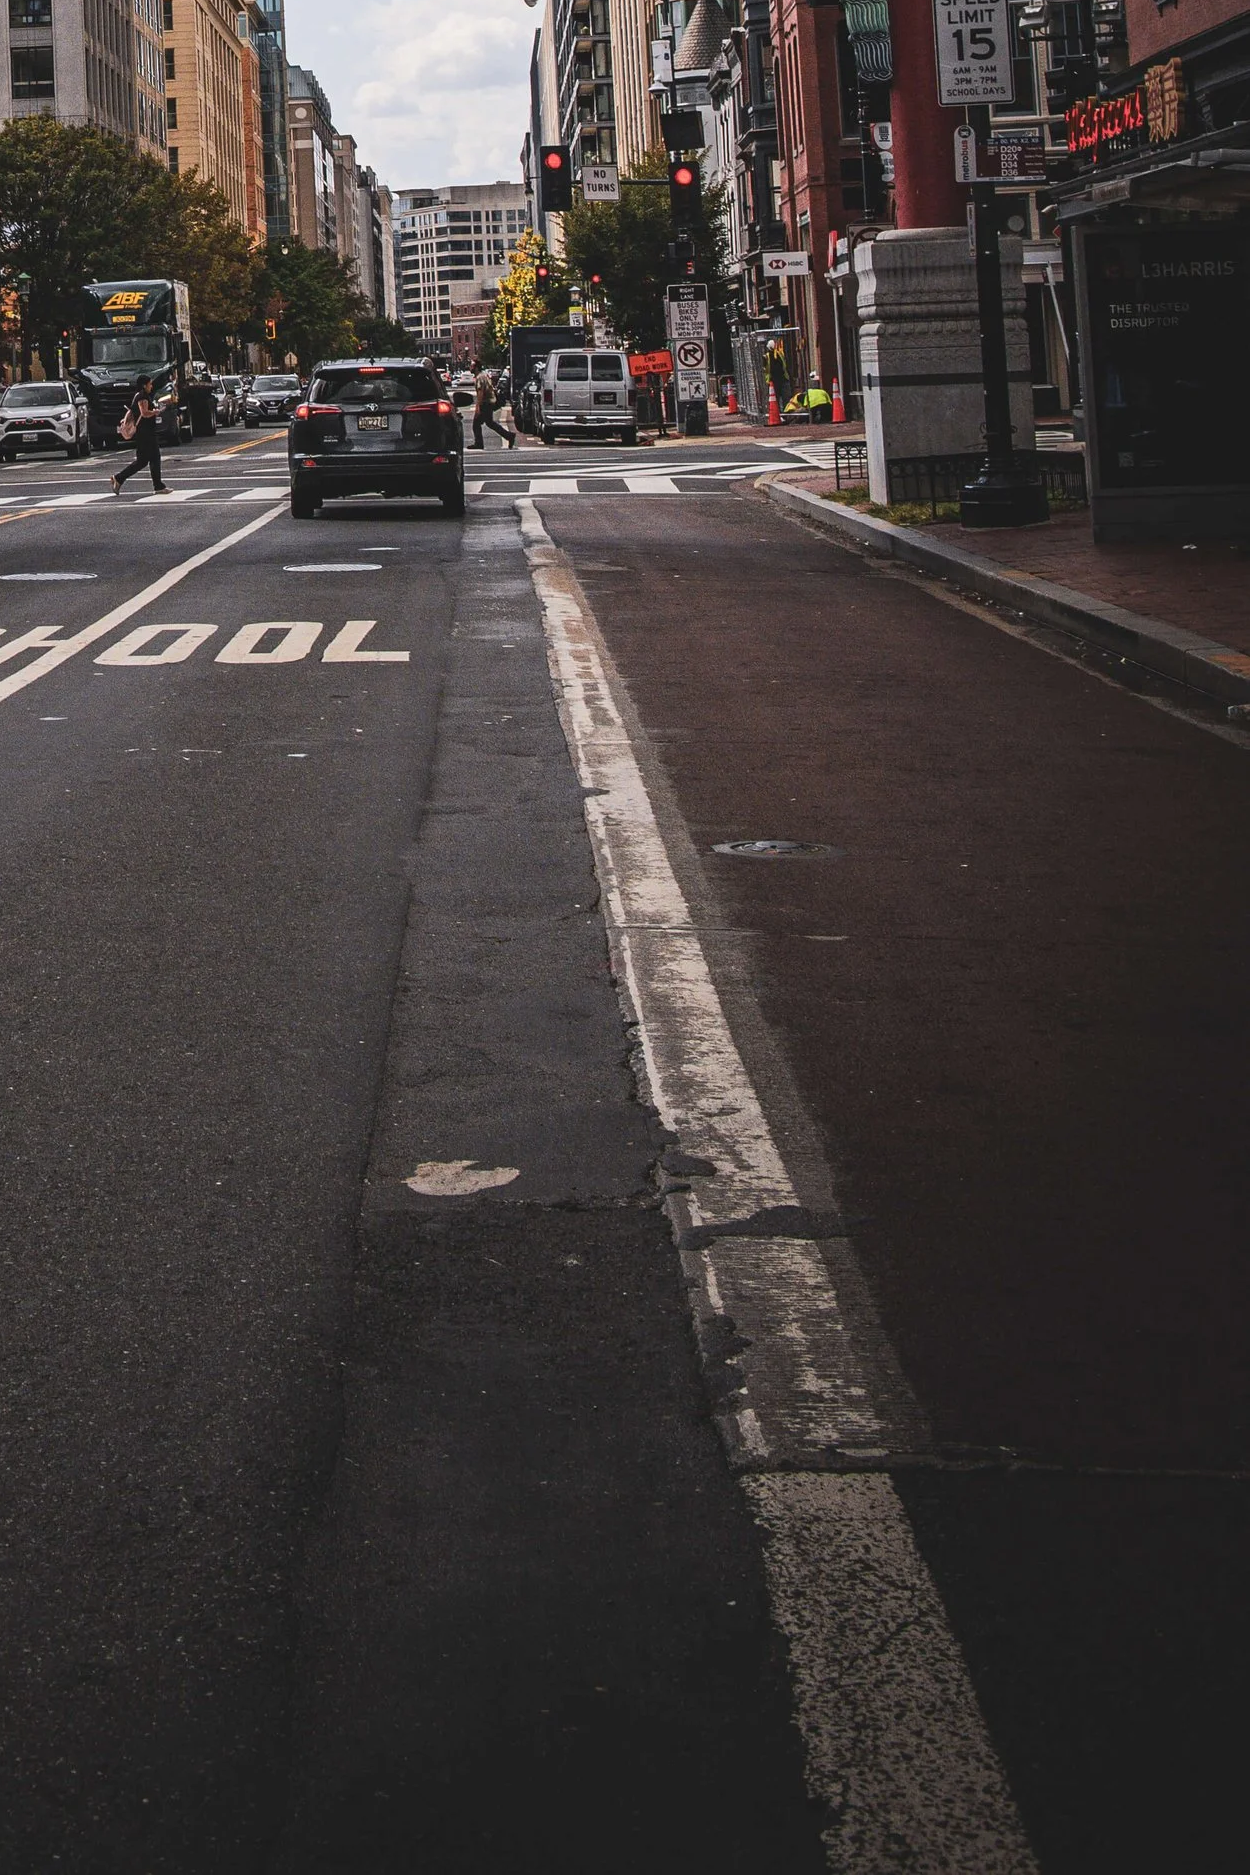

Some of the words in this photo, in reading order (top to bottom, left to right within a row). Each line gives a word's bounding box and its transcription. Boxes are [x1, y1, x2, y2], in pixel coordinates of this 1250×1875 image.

[947, 9, 995, 24] LIMIT
[952, 28, 996, 61] 15
[953, 67, 970, 75] 6AM
[954, 78, 971, 86] 3PM
[947, 89, 980, 97] SCHOOL
[961, 140, 971, 181] metrobus
[593, 170, 606, 178] NO
[587, 183, 616, 192] TURNS
[1141, 260, 1235, 278] L3HARRIS
[104, 292, 150, 305] ABF
[1109, 304, 1133, 314] THE
[1136, 302, 1190, 314] TRUSTED
[1110, 317, 1180, 329] DISRUPTOR
[644, 355, 657, 363] END
